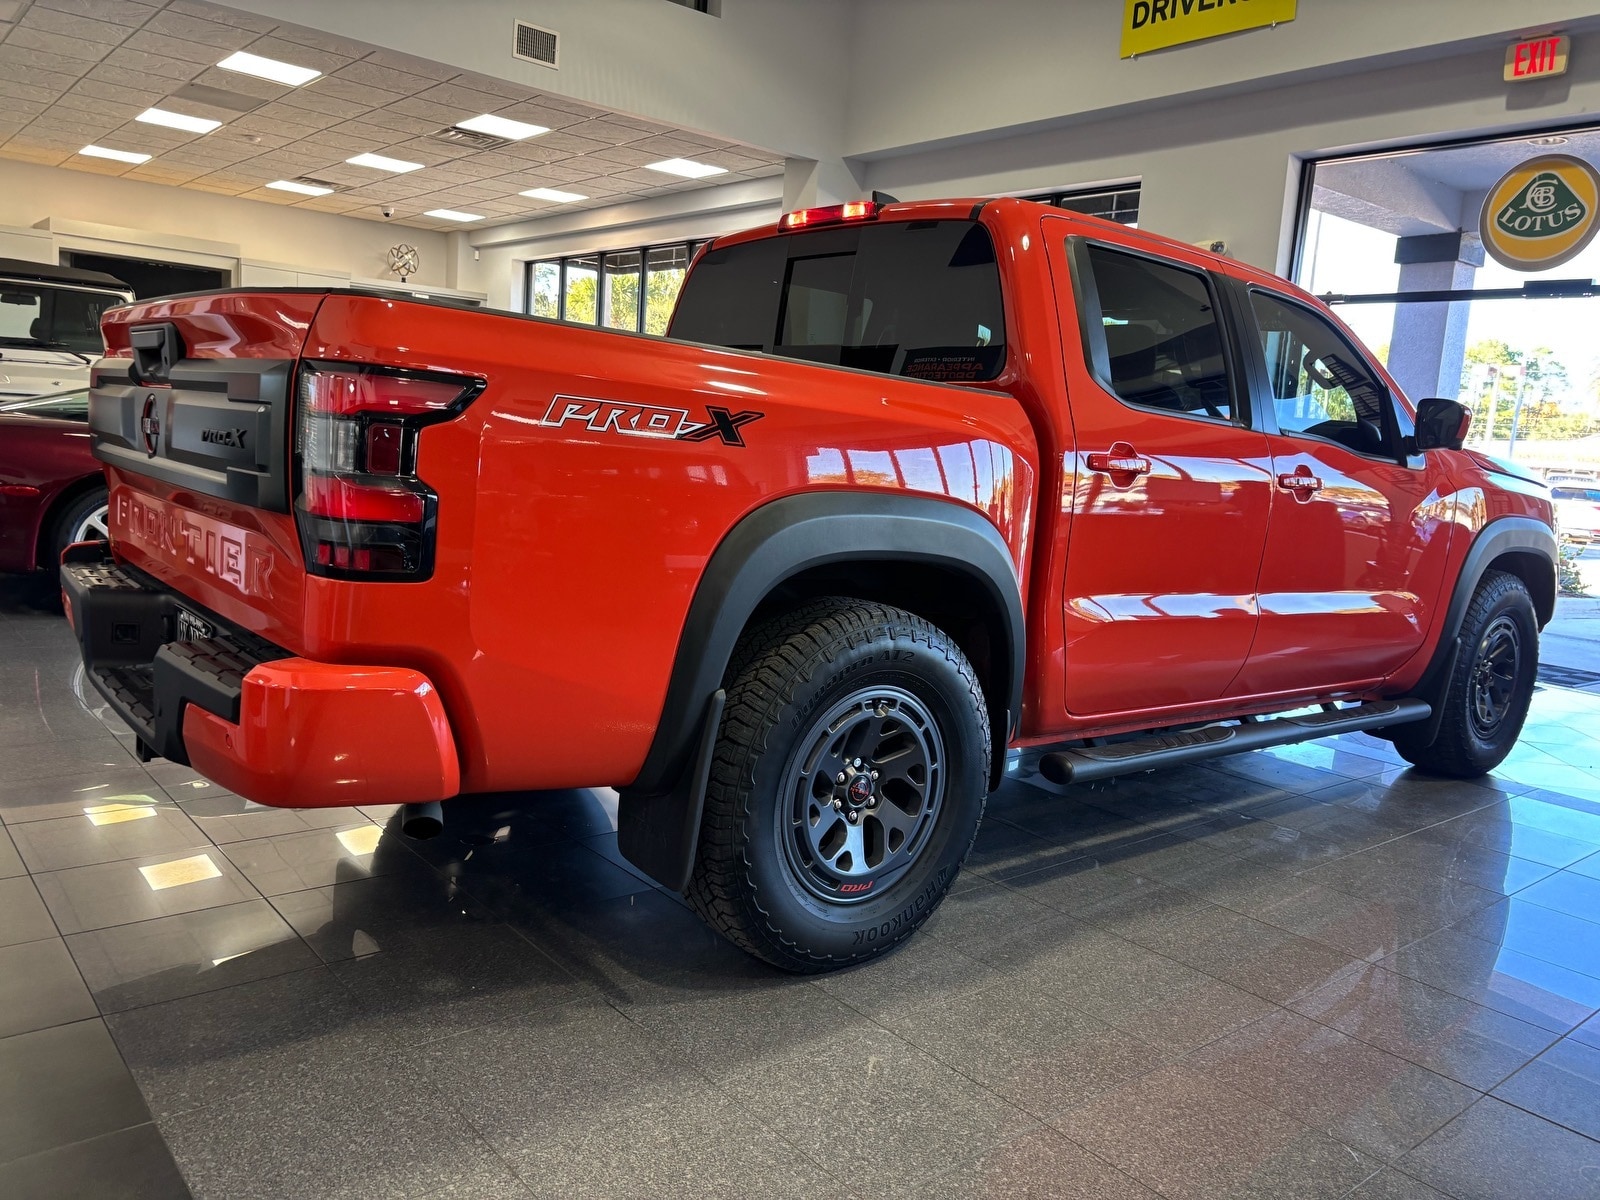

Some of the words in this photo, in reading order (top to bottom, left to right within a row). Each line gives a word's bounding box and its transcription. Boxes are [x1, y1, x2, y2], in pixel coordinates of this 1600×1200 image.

[1513, 37, 1561, 77] EXIT
[1499, 202, 1582, 232] LOTUS
[117, 493, 274, 600] FRONTIER
[839, 880, 875, 893] PRO
